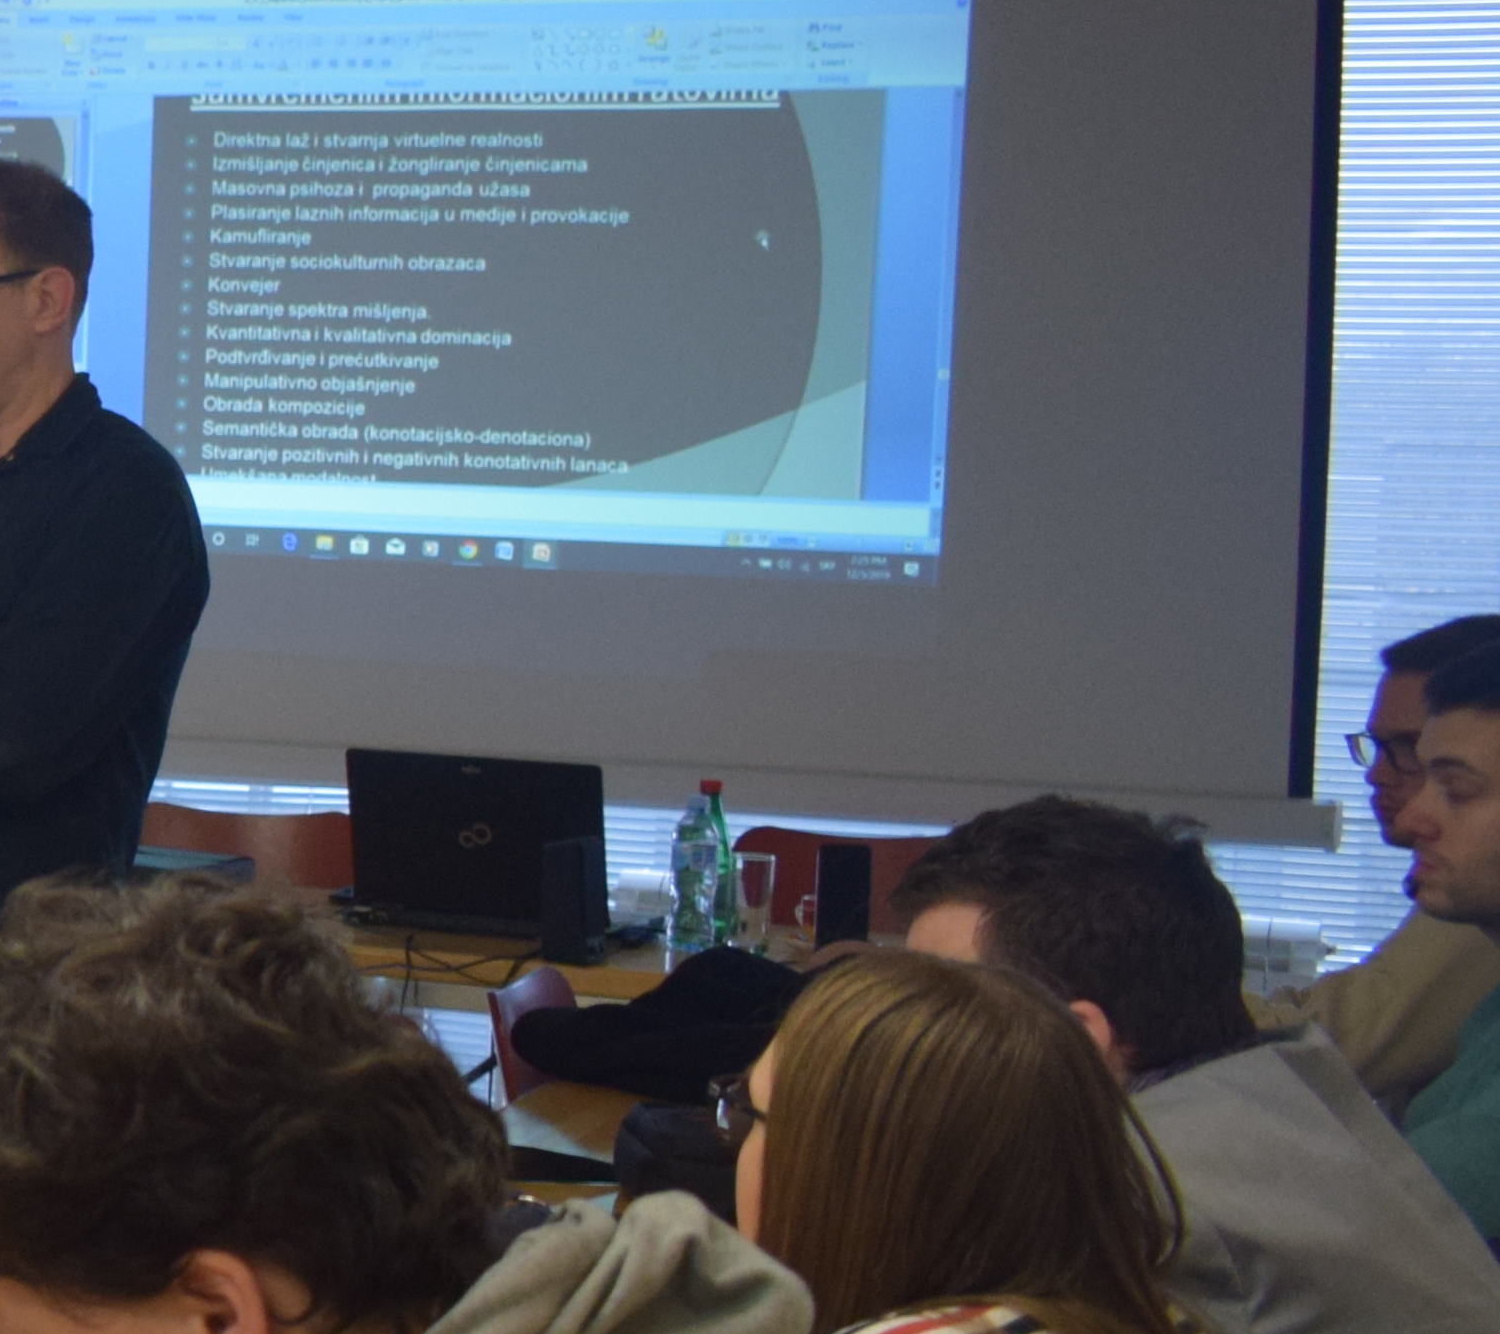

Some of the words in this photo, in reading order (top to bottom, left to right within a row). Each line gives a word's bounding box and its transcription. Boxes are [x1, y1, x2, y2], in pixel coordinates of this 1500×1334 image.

[213, 130, 282, 148] Direktna
[393, 132, 466, 147] virtuelne
[470, 132, 544, 147] realnosti
[211, 179, 286, 196] Masovna
[289, 182, 354, 198] psihoza
[371, 182, 473, 199] propaganda
[479, 182, 531, 197] užasa
[210, 203, 291, 222] Plasiranje
[347, 206, 440, 225] informacija
[443, 210, 455, 222] u
[459, 208, 517, 226] medije
[529, 208, 630, 227] provokacije
[209, 228, 312, 247] Kamufliranje
[208, 252, 286, 271] Stvaranje
[289, 254, 404, 270] sociokulturnih
[407, 255, 486, 271] obrazaca
[207, 277, 281, 294] Konvejer
[206, 300, 284, 318] Stvaranje
[287, 302, 349, 319] spektra
[322, 327, 417, 344] kvalitativna
[420, 329, 513, 349] dominacija
[203, 372, 317, 390] Manipulativno
[202, 395, 263, 412] Obrada
[267, 398, 365, 418] kompozicije
[301, 424, 359, 439] obrada
[201, 443, 278, 463] Stvaranje
[281, 449, 359, 465] pozitivnih
[372, 452, 459, 469] negativnih
[463, 453, 568, 470] konotativnih
[570, 457, 629, 473] lanaca
